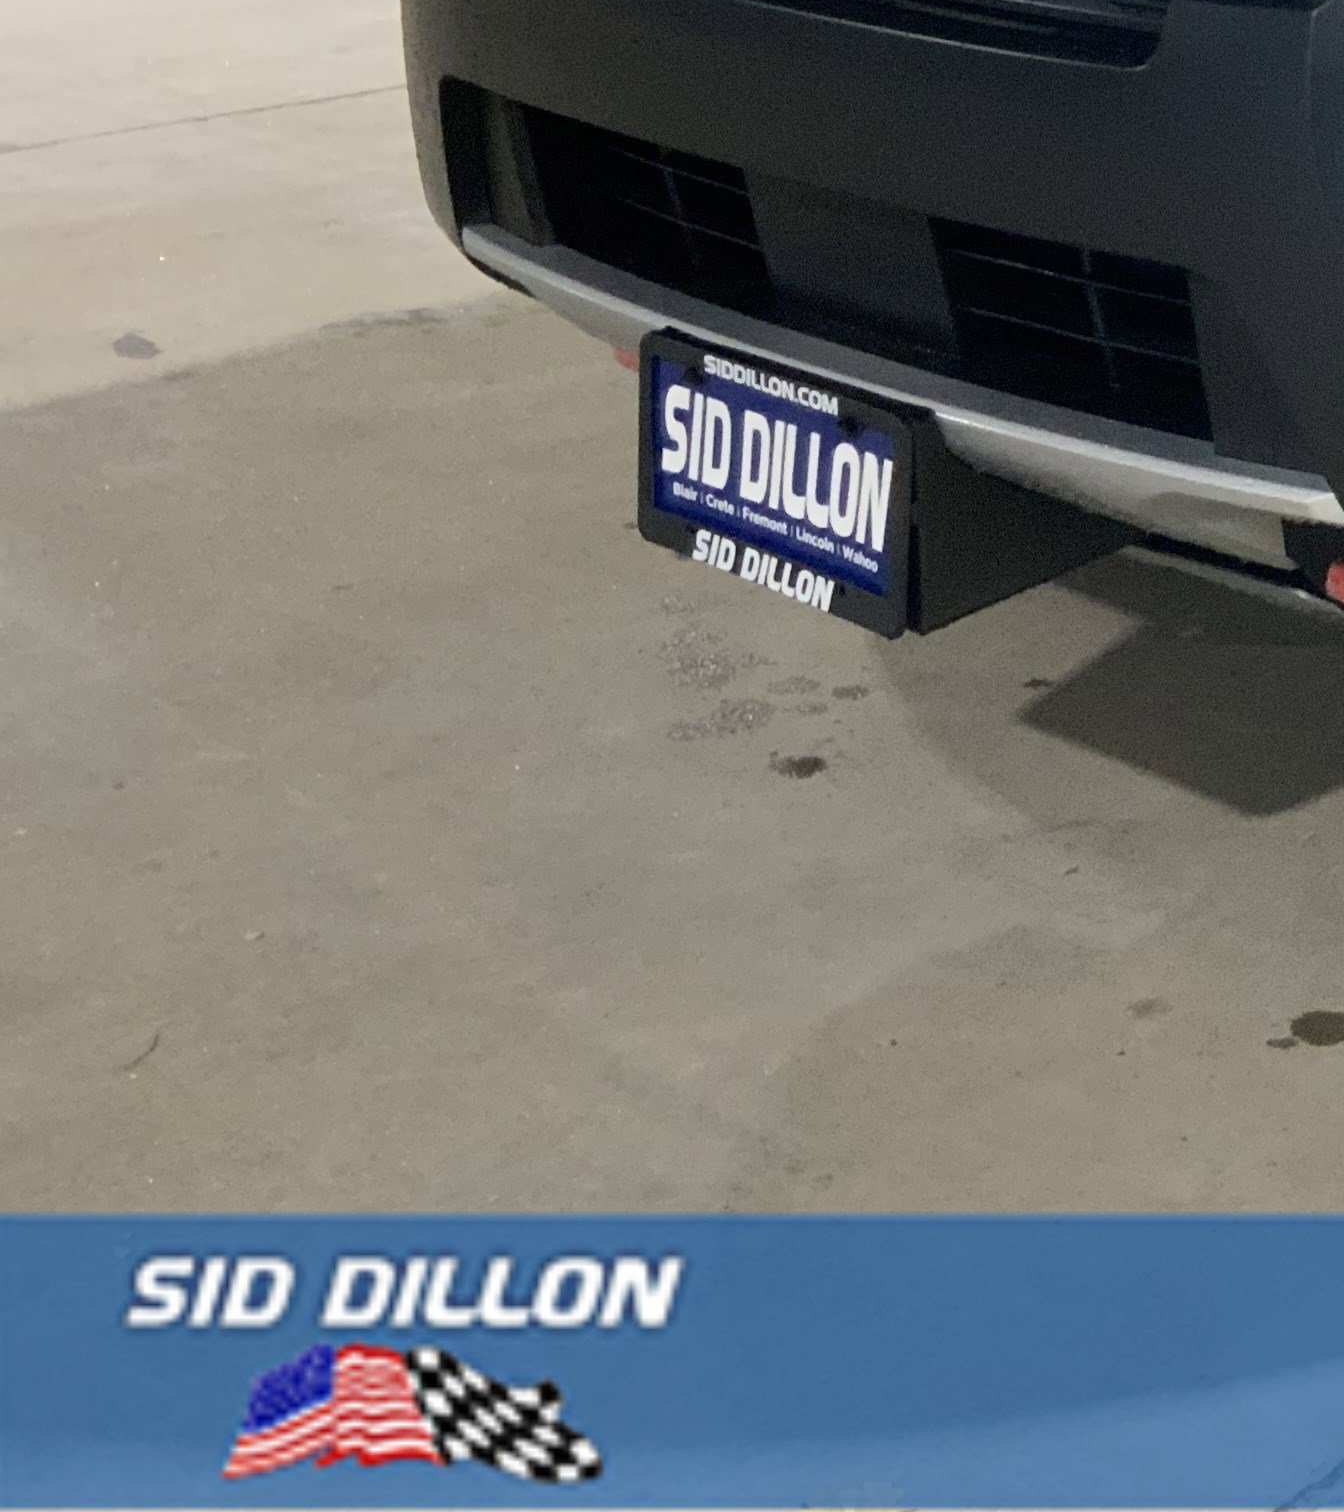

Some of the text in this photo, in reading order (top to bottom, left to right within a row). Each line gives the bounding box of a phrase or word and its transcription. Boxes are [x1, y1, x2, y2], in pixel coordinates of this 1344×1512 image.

[703, 354, 838, 417] SIDDILLON.COM
[661, 384, 893, 553] SID DILLON
[673, 481, 879, 573] Blair Crete Fremont Lincoln Wahoo
[691, 528, 835, 614] SID DILLON
